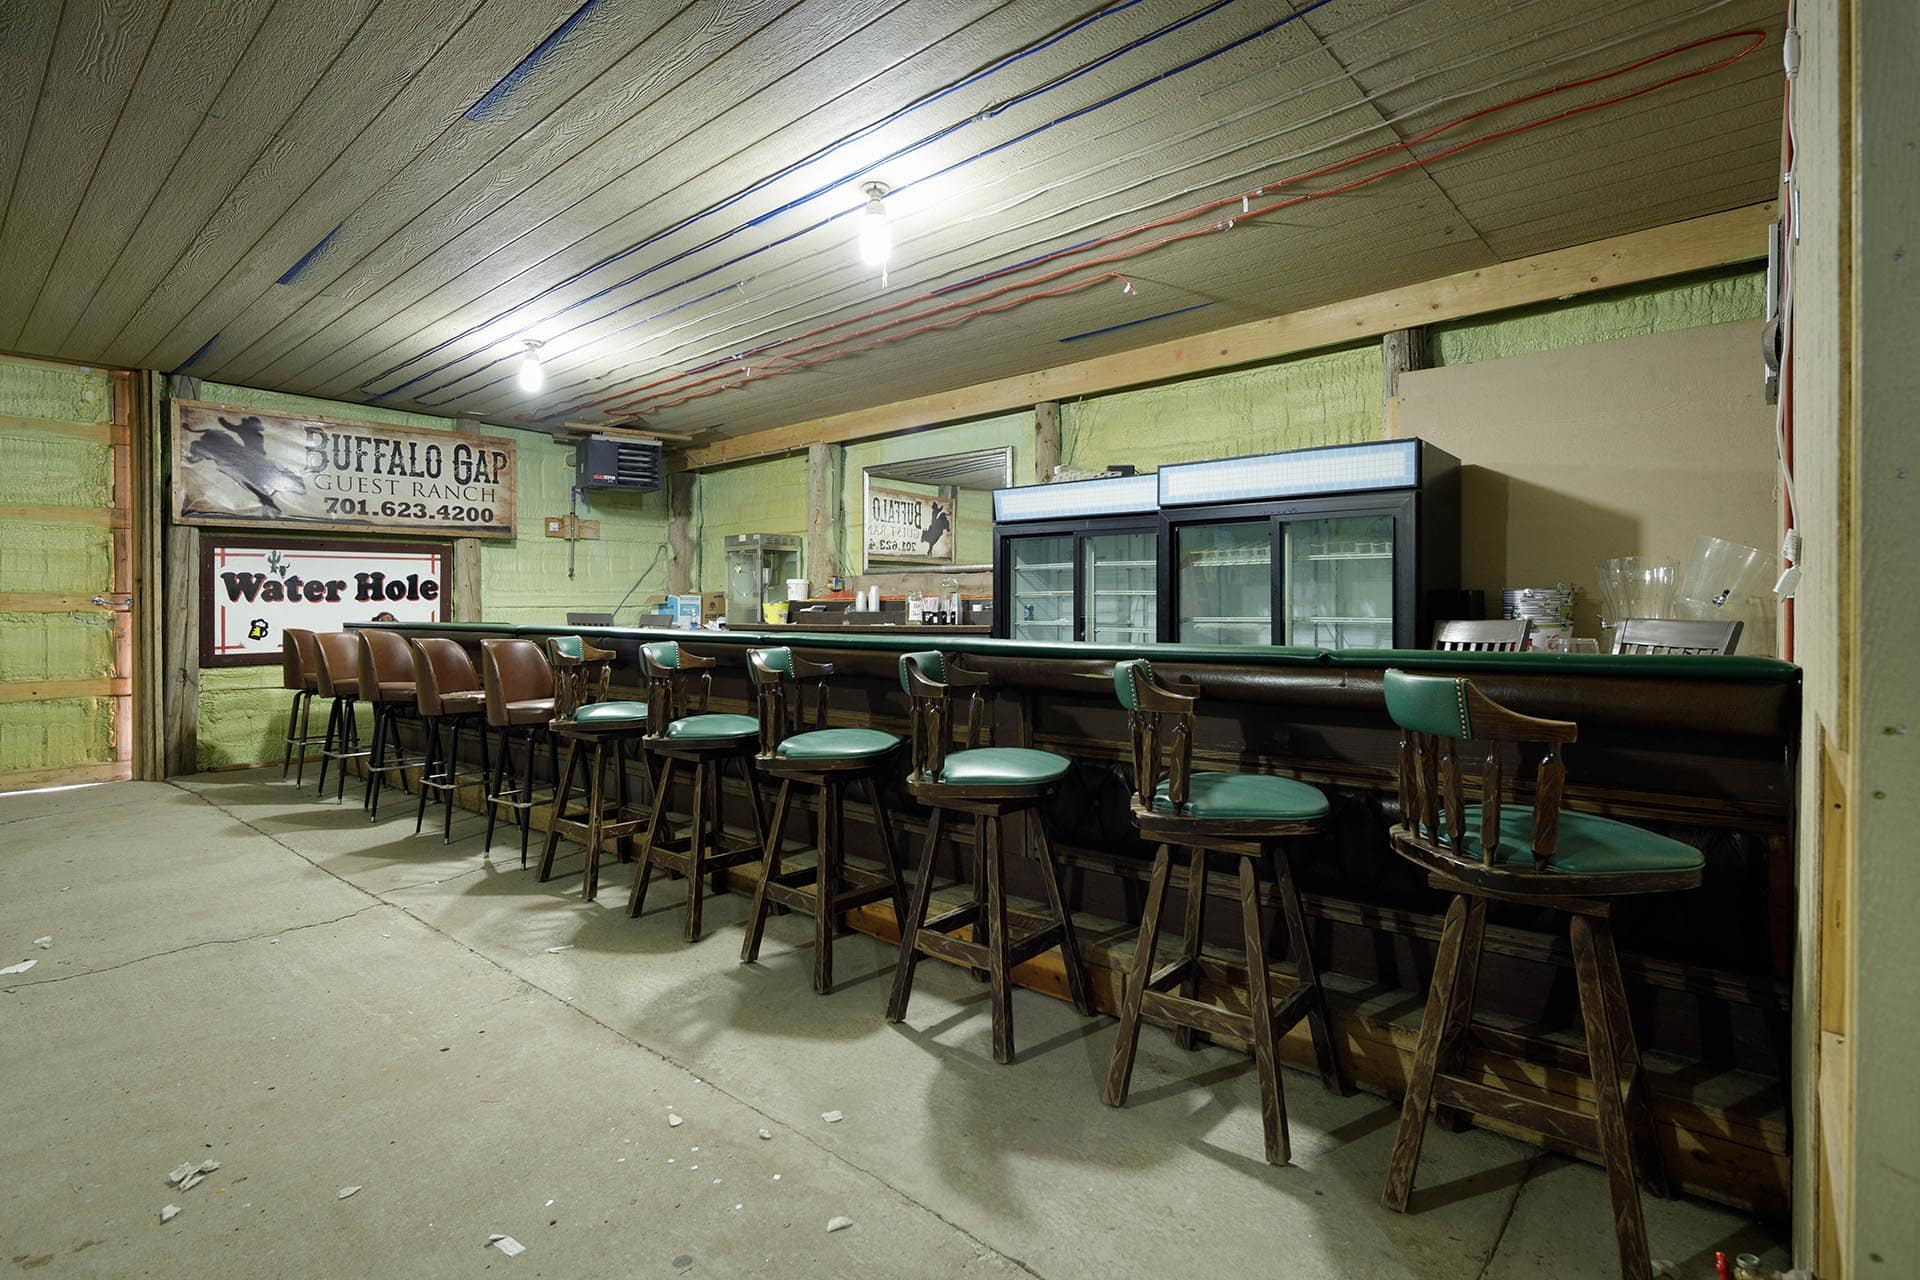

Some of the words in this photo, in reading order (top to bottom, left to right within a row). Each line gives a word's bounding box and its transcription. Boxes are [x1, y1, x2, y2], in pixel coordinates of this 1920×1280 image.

[303, 426, 443, 479] BUFFALO
[452, 443, 509, 486] GAP
[314, 473, 400, 495] GUEST
[412, 482, 496, 503] RANCH
[324, 497, 494, 523] 701.623.4200
[220, 571, 348, 603] Water
[354, 571, 439, 603] Hole
